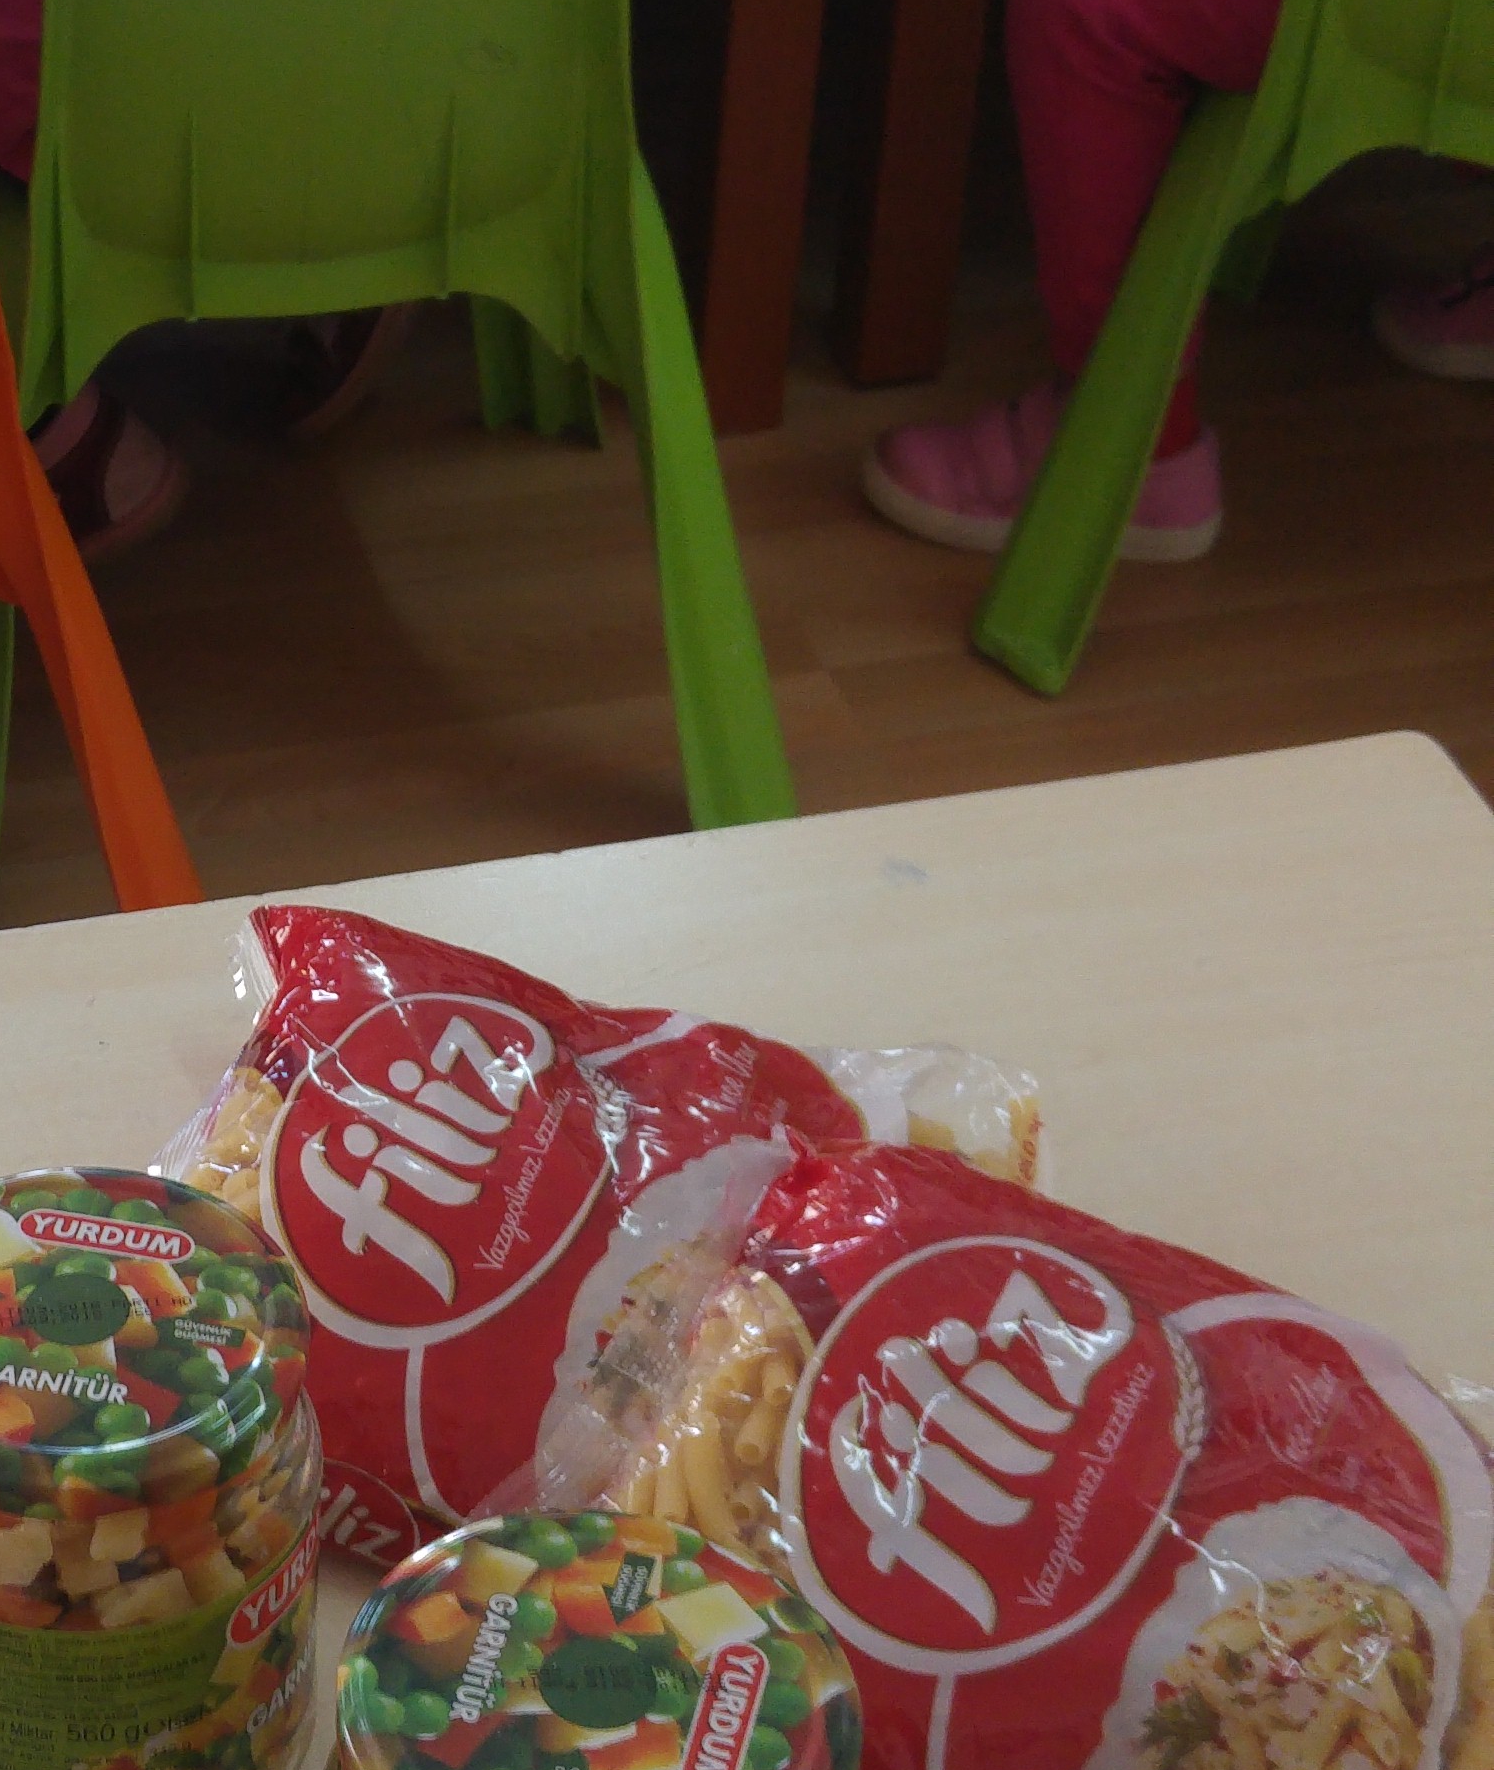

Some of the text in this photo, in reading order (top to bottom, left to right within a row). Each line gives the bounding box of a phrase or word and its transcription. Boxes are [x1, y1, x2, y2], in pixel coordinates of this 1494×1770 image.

[297, 1007, 556, 1307] filiz
[32, 1213, 183, 1259] YURDUM
[829, 1268, 1134, 1636] filiz
[316, 1483, 402, 1566] liz
[449, 1592, 518, 1724] GARNİTÜR
